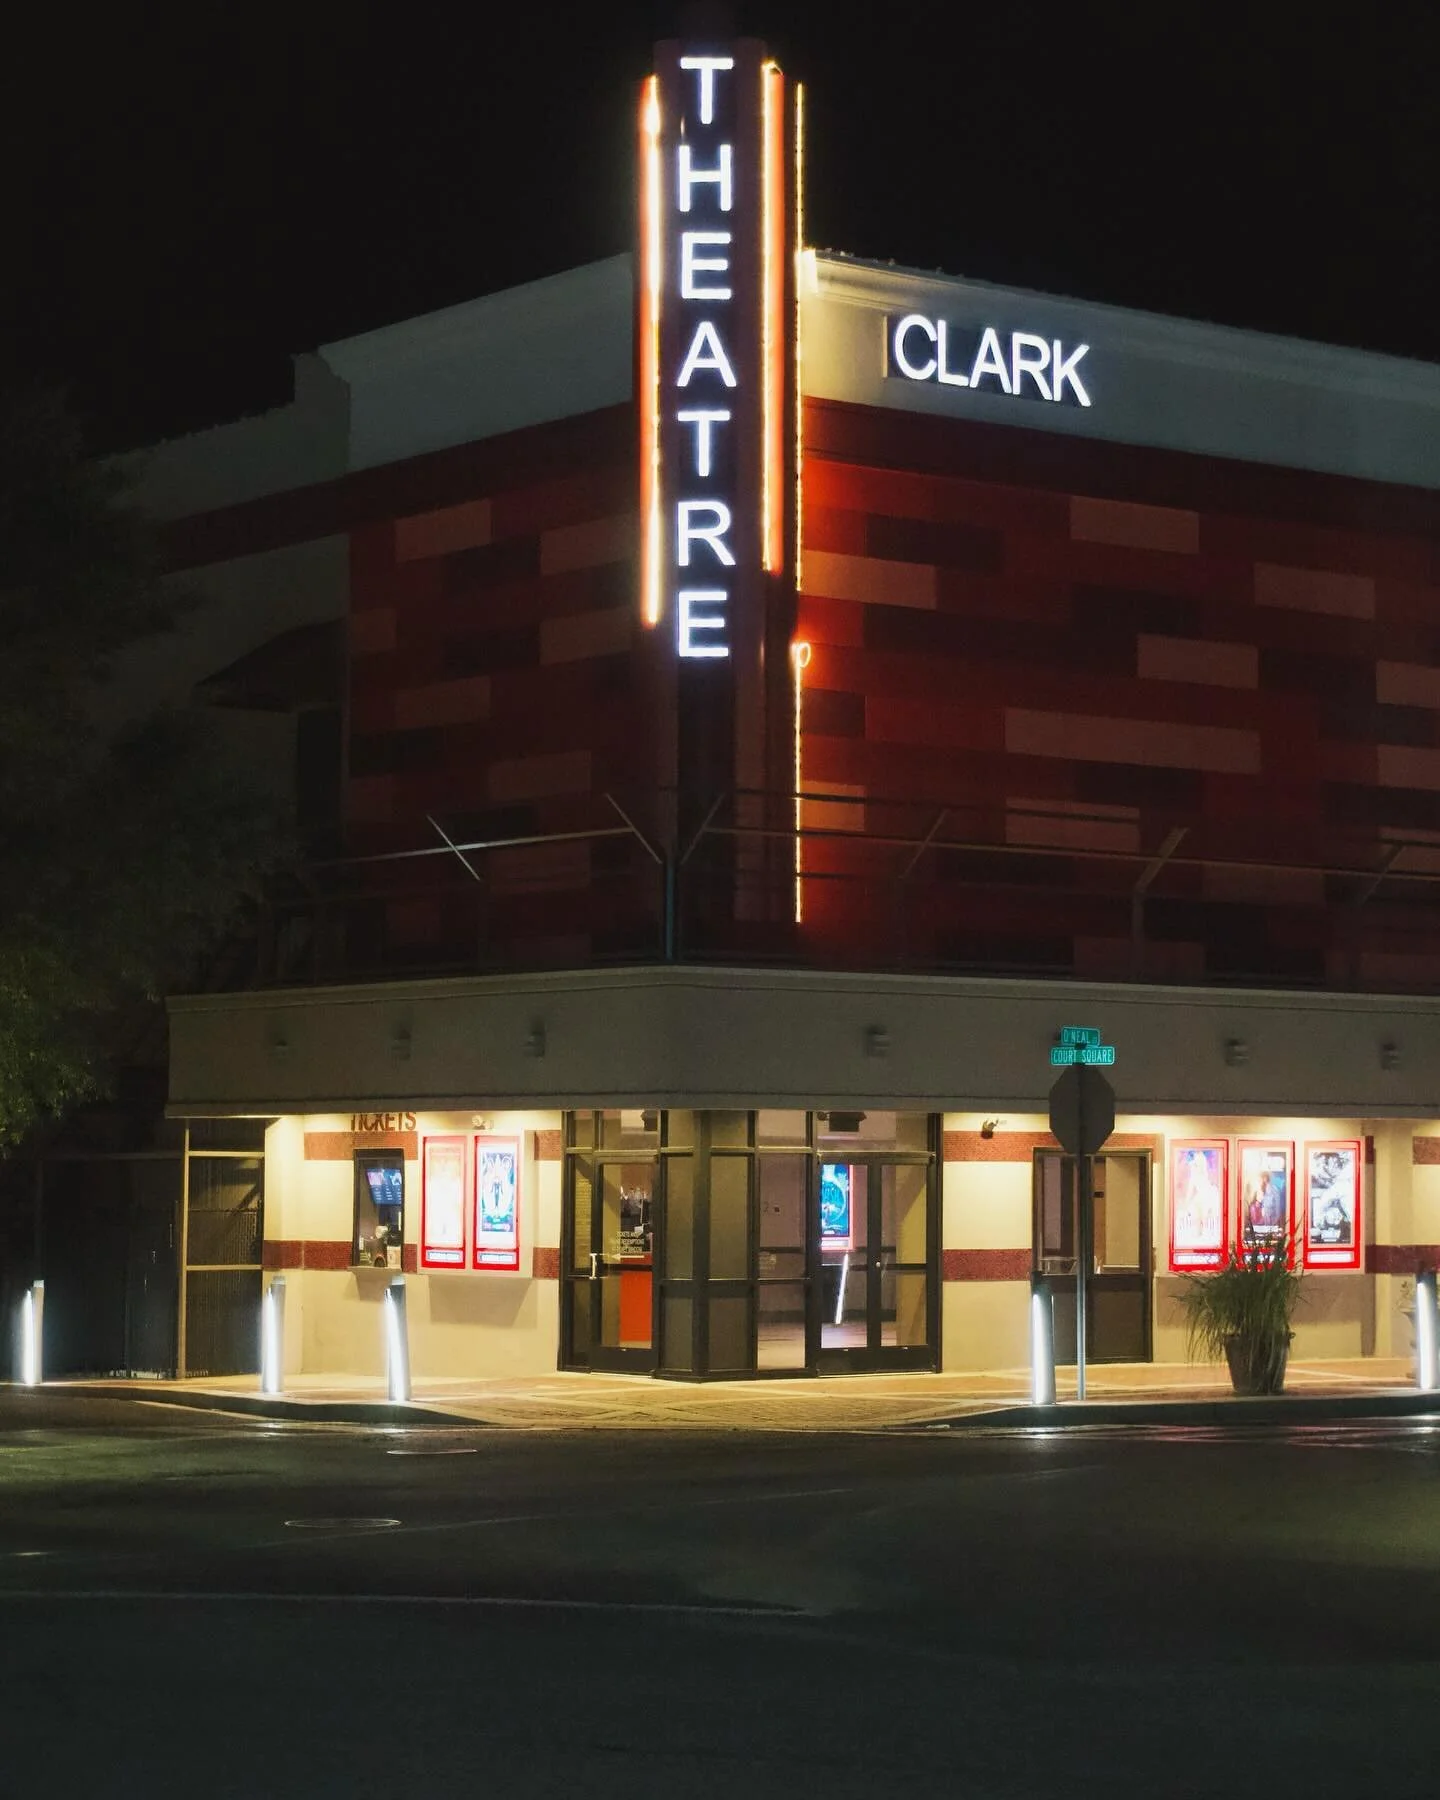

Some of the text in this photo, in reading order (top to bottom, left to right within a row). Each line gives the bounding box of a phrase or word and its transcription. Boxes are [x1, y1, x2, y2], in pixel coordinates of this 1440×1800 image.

[676, 57, 737, 658] THEATRE
[894, 314, 1092, 407] CLARK
[1053, 1049, 1112, 1063] COURT SQUARE
[350, 1111, 418, 1132] TICKETS
